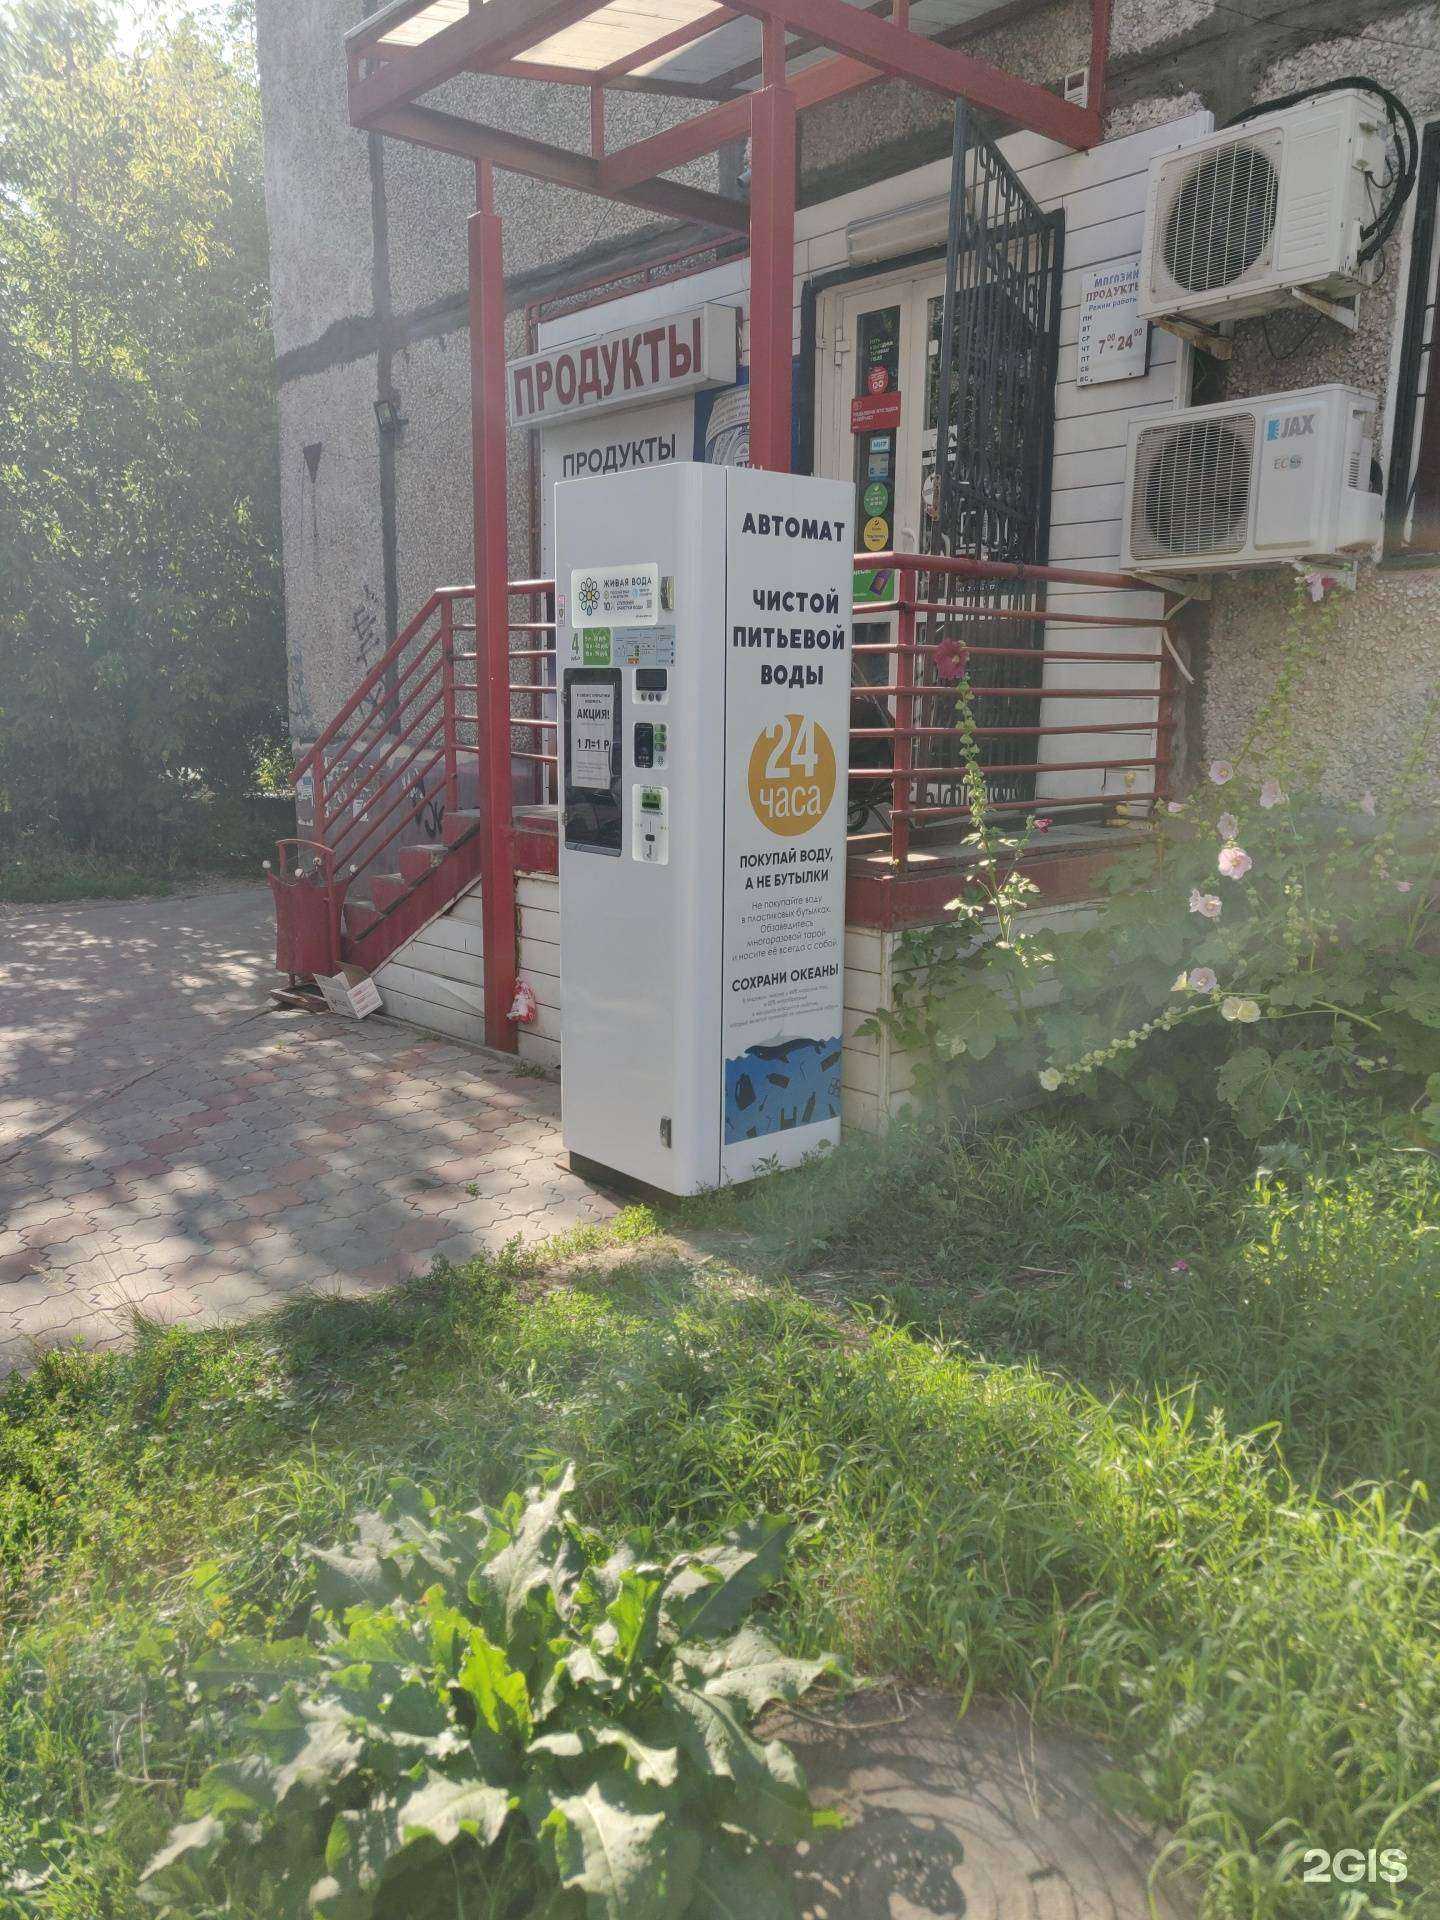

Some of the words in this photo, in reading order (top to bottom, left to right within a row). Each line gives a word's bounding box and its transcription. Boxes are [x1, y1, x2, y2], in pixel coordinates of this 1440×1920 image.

[514, 317, 701, 416] ПРОДУКТЫ
[1281, 414, 1315, 439] JAX
[562, 433, 676, 477] ПРОДУКТЫ
[742, 512, 845, 542] АВТОМАТ
[603, 578, 629, 588] ЖИВАЯ
[632, 577, 652, 586] ВОДА
[753, 587, 839, 614] ЧИСТОЙ
[733, 624, 845, 650] ПИТЬЕВОЙ
[760, 664, 824, 689] ВОДЫ
[577, 708, 610, 720] АКЦИЯ!
[765, 714, 819, 779] 24
[760, 785, 822, 818] часа
[740, 848, 797, 868] ПОКУПАЙ
[800, 848, 833, 864] ВОДУ,
[745, 877, 754, 890] А
[757, 875, 771, 888] НЕ
[774, 869, 829, 887] БУТЫЛКИ
[732, 971, 787, 992] СОХРАНИ
[790, 963, 839, 981] ОКЕАНЫ
